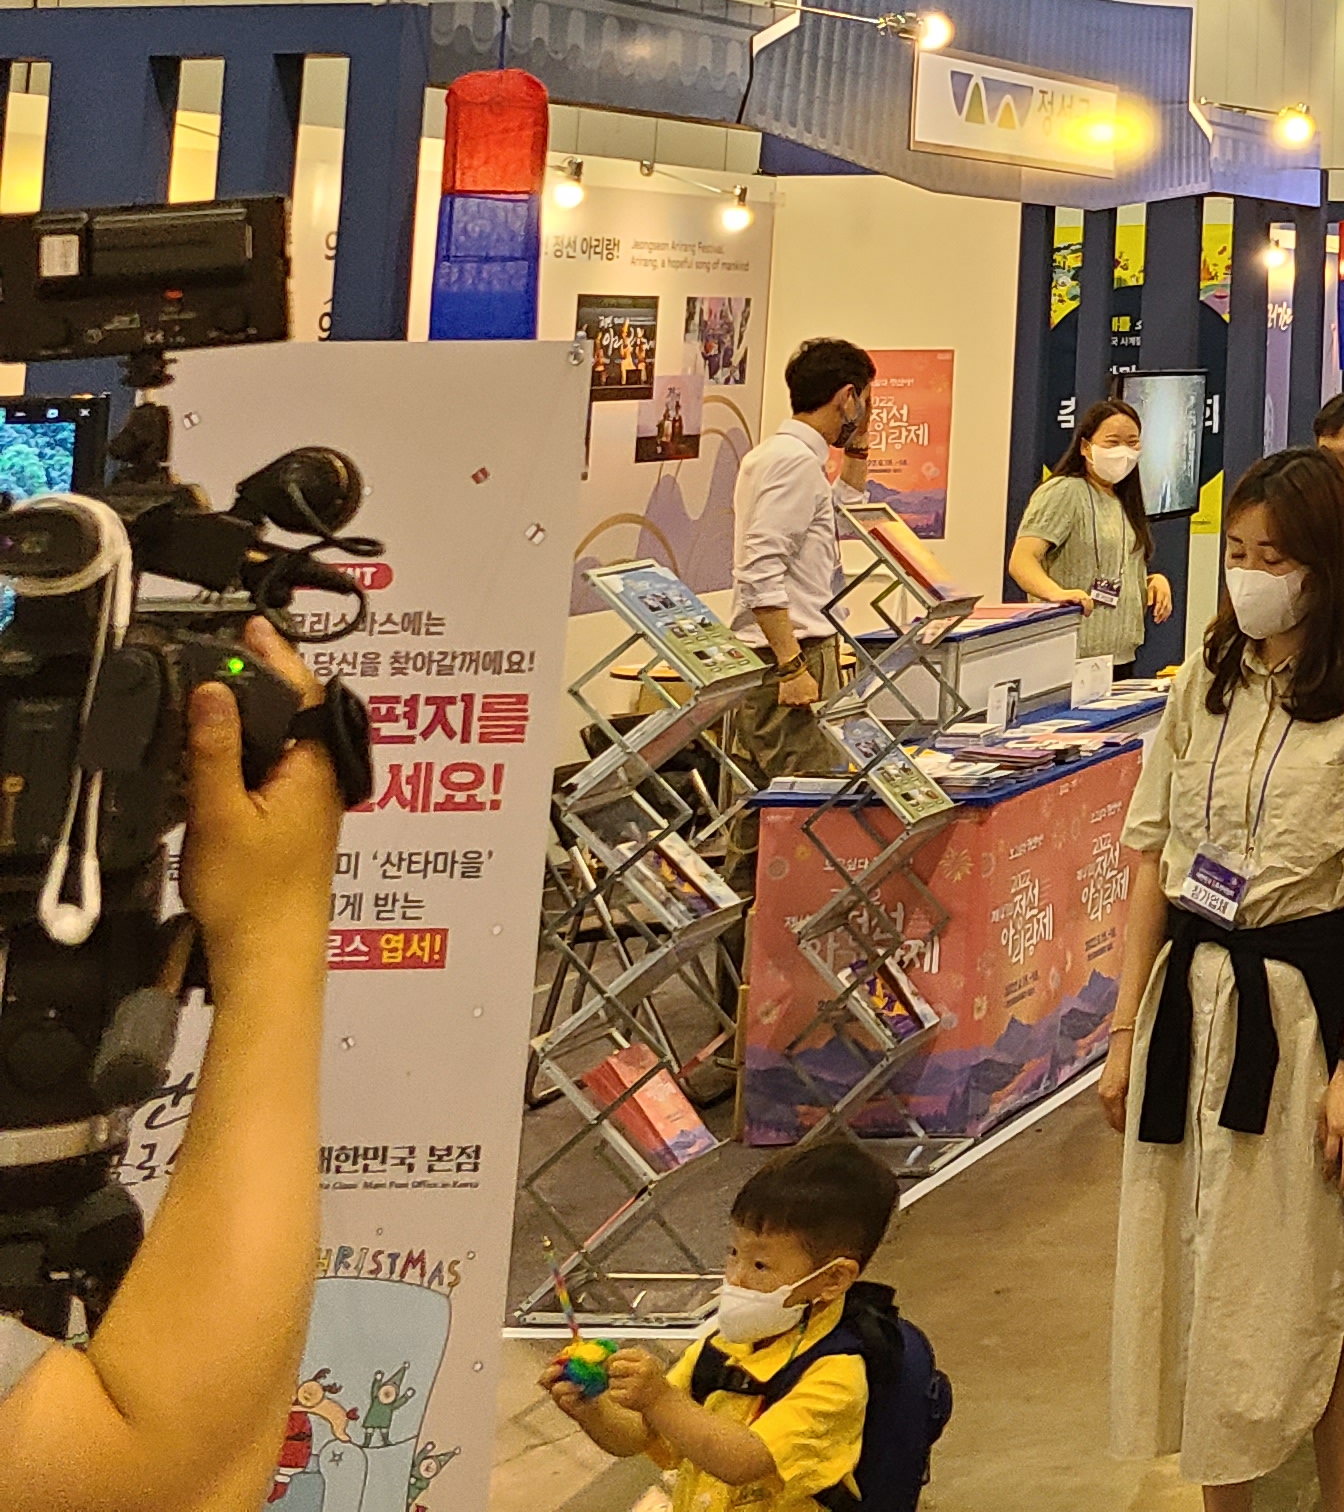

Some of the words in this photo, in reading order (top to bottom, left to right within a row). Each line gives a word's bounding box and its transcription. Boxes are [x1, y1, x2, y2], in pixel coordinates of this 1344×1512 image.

[1038, 89, 1090, 136] 정선
[581, 237, 620, 262] 아리랑!
[870, 404, 909, 431] 정선
[868, 423, 929, 452] 리랑제
[313, 651, 381, 677] 당신을
[390, 651, 535, 676] 찾아갈꺼에요!
[368, 693, 529, 744] 편지를
[374, 892, 425, 922] 받는
[380, 933, 442, 964] 엽서!
[1001, 903, 1053, 965] 아리랑제
[427, 1144, 481, 1174] 본점
[317, 1245, 462, 1289] HRISTMAS
